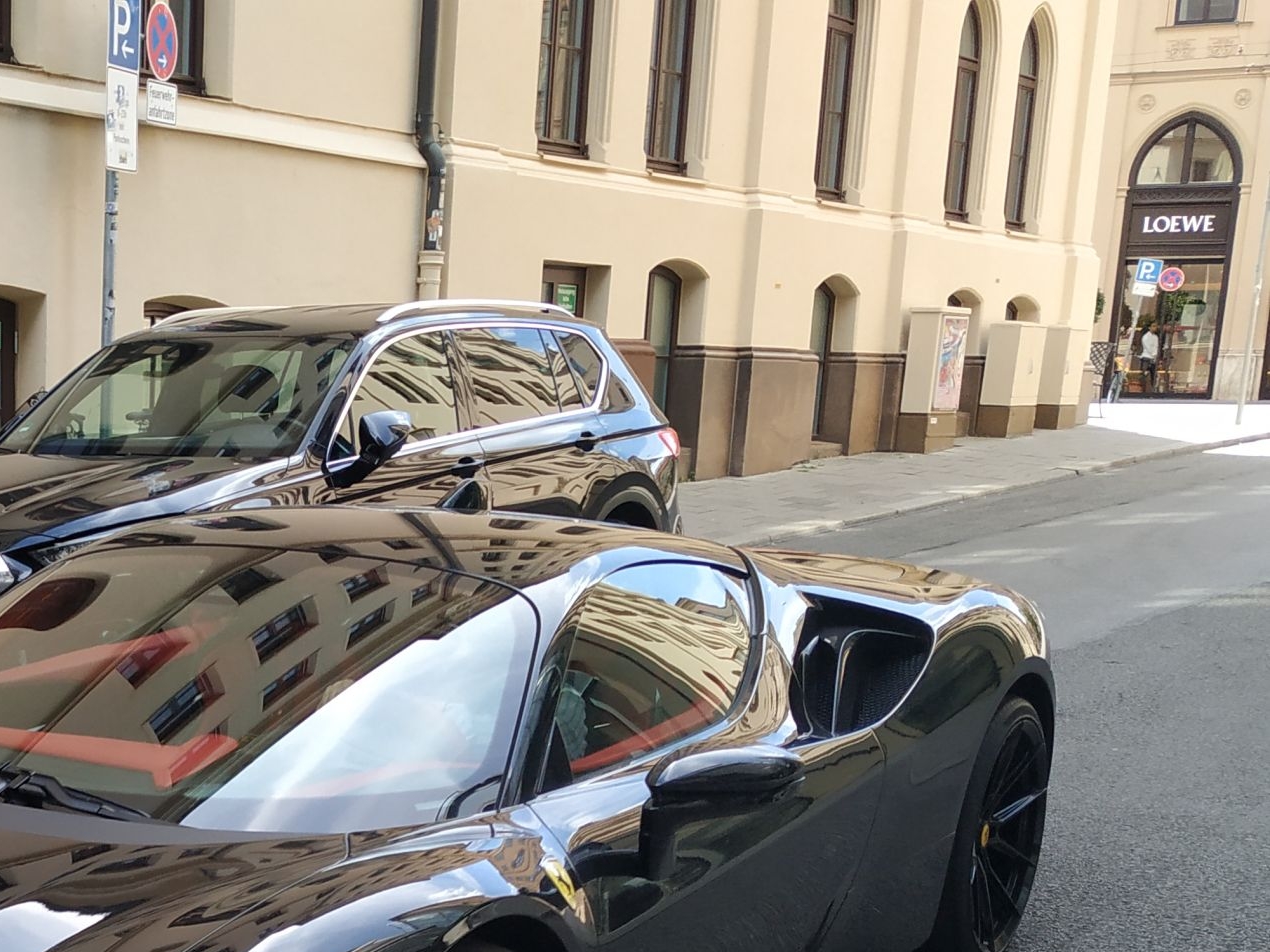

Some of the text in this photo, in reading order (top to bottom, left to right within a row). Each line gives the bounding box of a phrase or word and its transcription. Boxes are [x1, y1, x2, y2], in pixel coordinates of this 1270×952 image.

[113, 0, 131, 56] P
[1142, 215, 1216, 233] LOEWE
[1139, 261, 1155, 279] P
